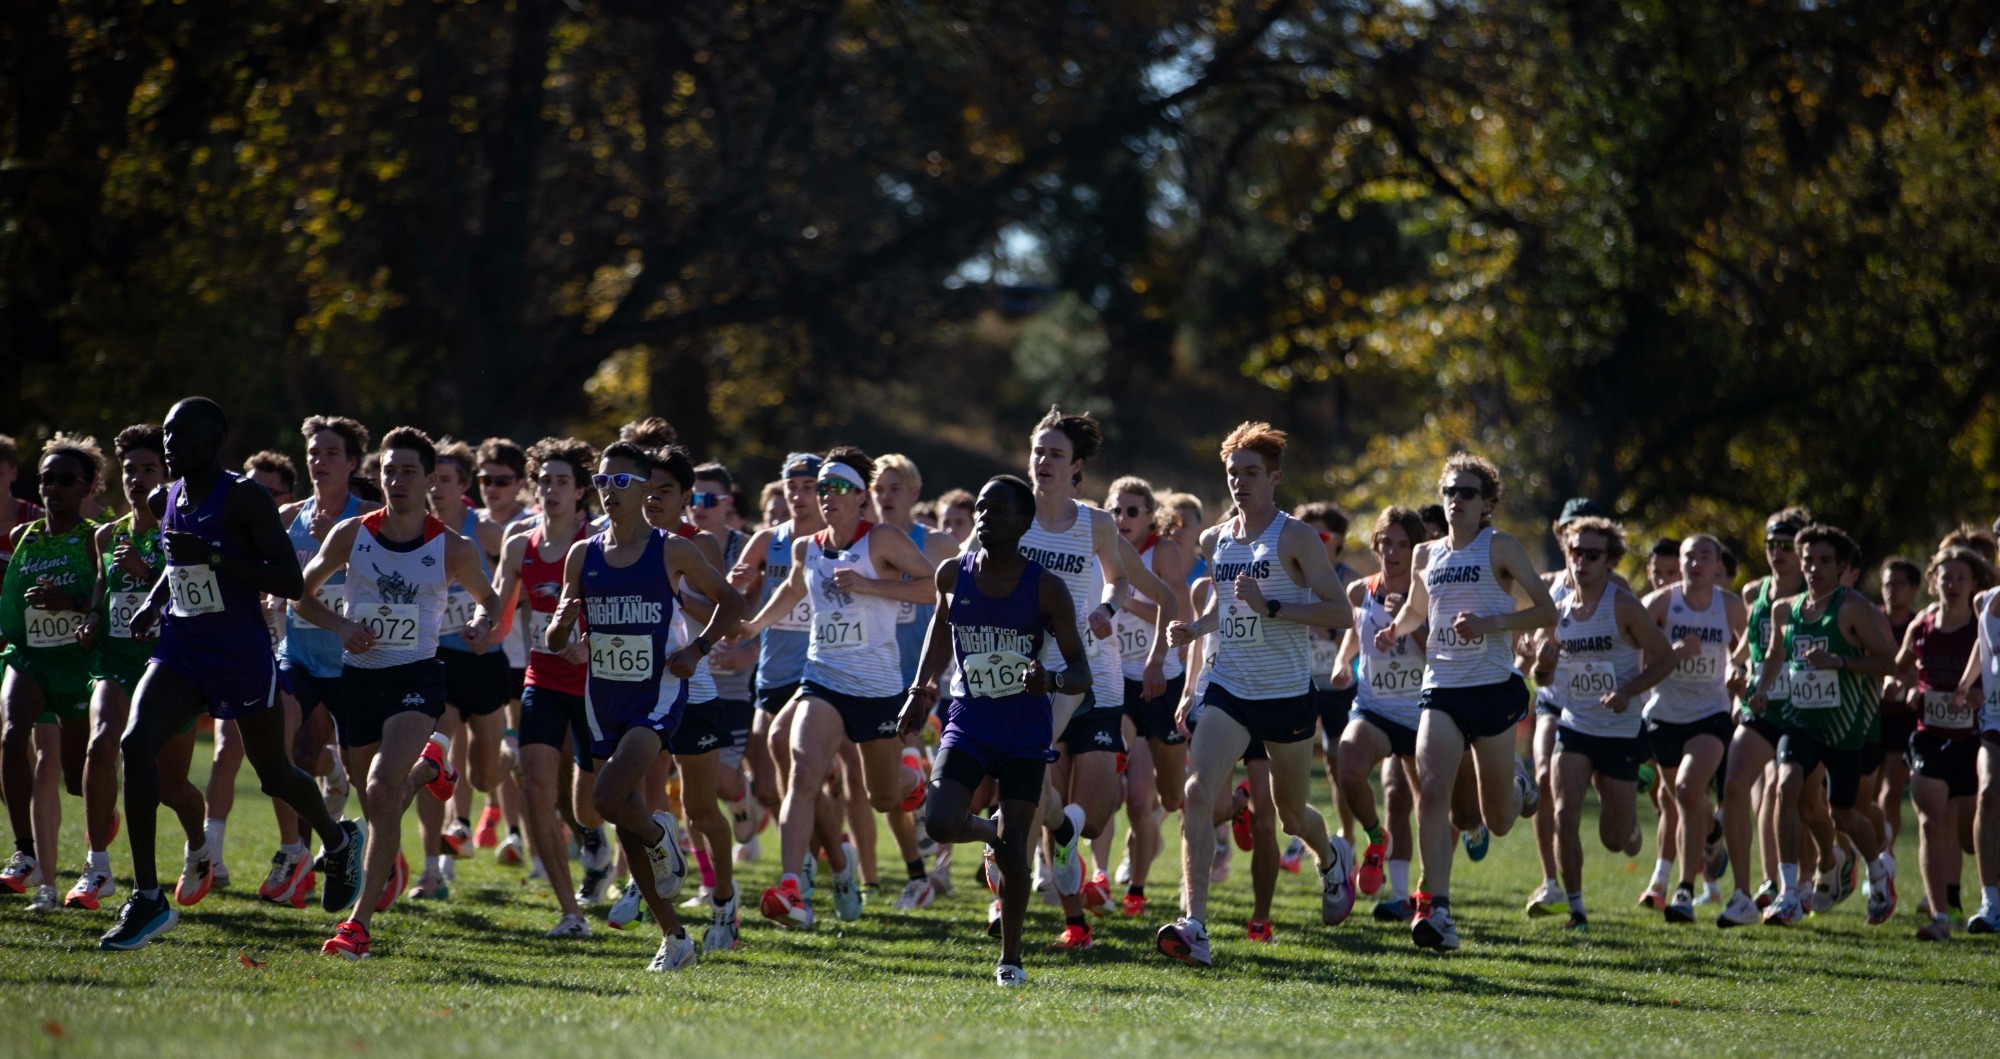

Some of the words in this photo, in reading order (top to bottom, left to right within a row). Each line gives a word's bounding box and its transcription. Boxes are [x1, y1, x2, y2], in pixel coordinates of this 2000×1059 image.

[20, 553, 69, 575] Adams
[1427, 565, 1481, 586] COUGARS
[585, 596, 602, 605] NEW
[605, 595, 643, 604] MEXICO
[587, 602, 663, 626] HIGHLANDS
[816, 622, 863, 644] 4071
[957, 625, 977, 634] NEW
[979, 625, 1019, 637] MEXICO
[958, 632, 1036, 655] HIGHLANDS
[593, 649, 650, 672] 4165
[1371, 668, 1424, 691] 4079
[1571, 673, 1614, 692] 4050
[1792, 681, 1837, 700] 4014
